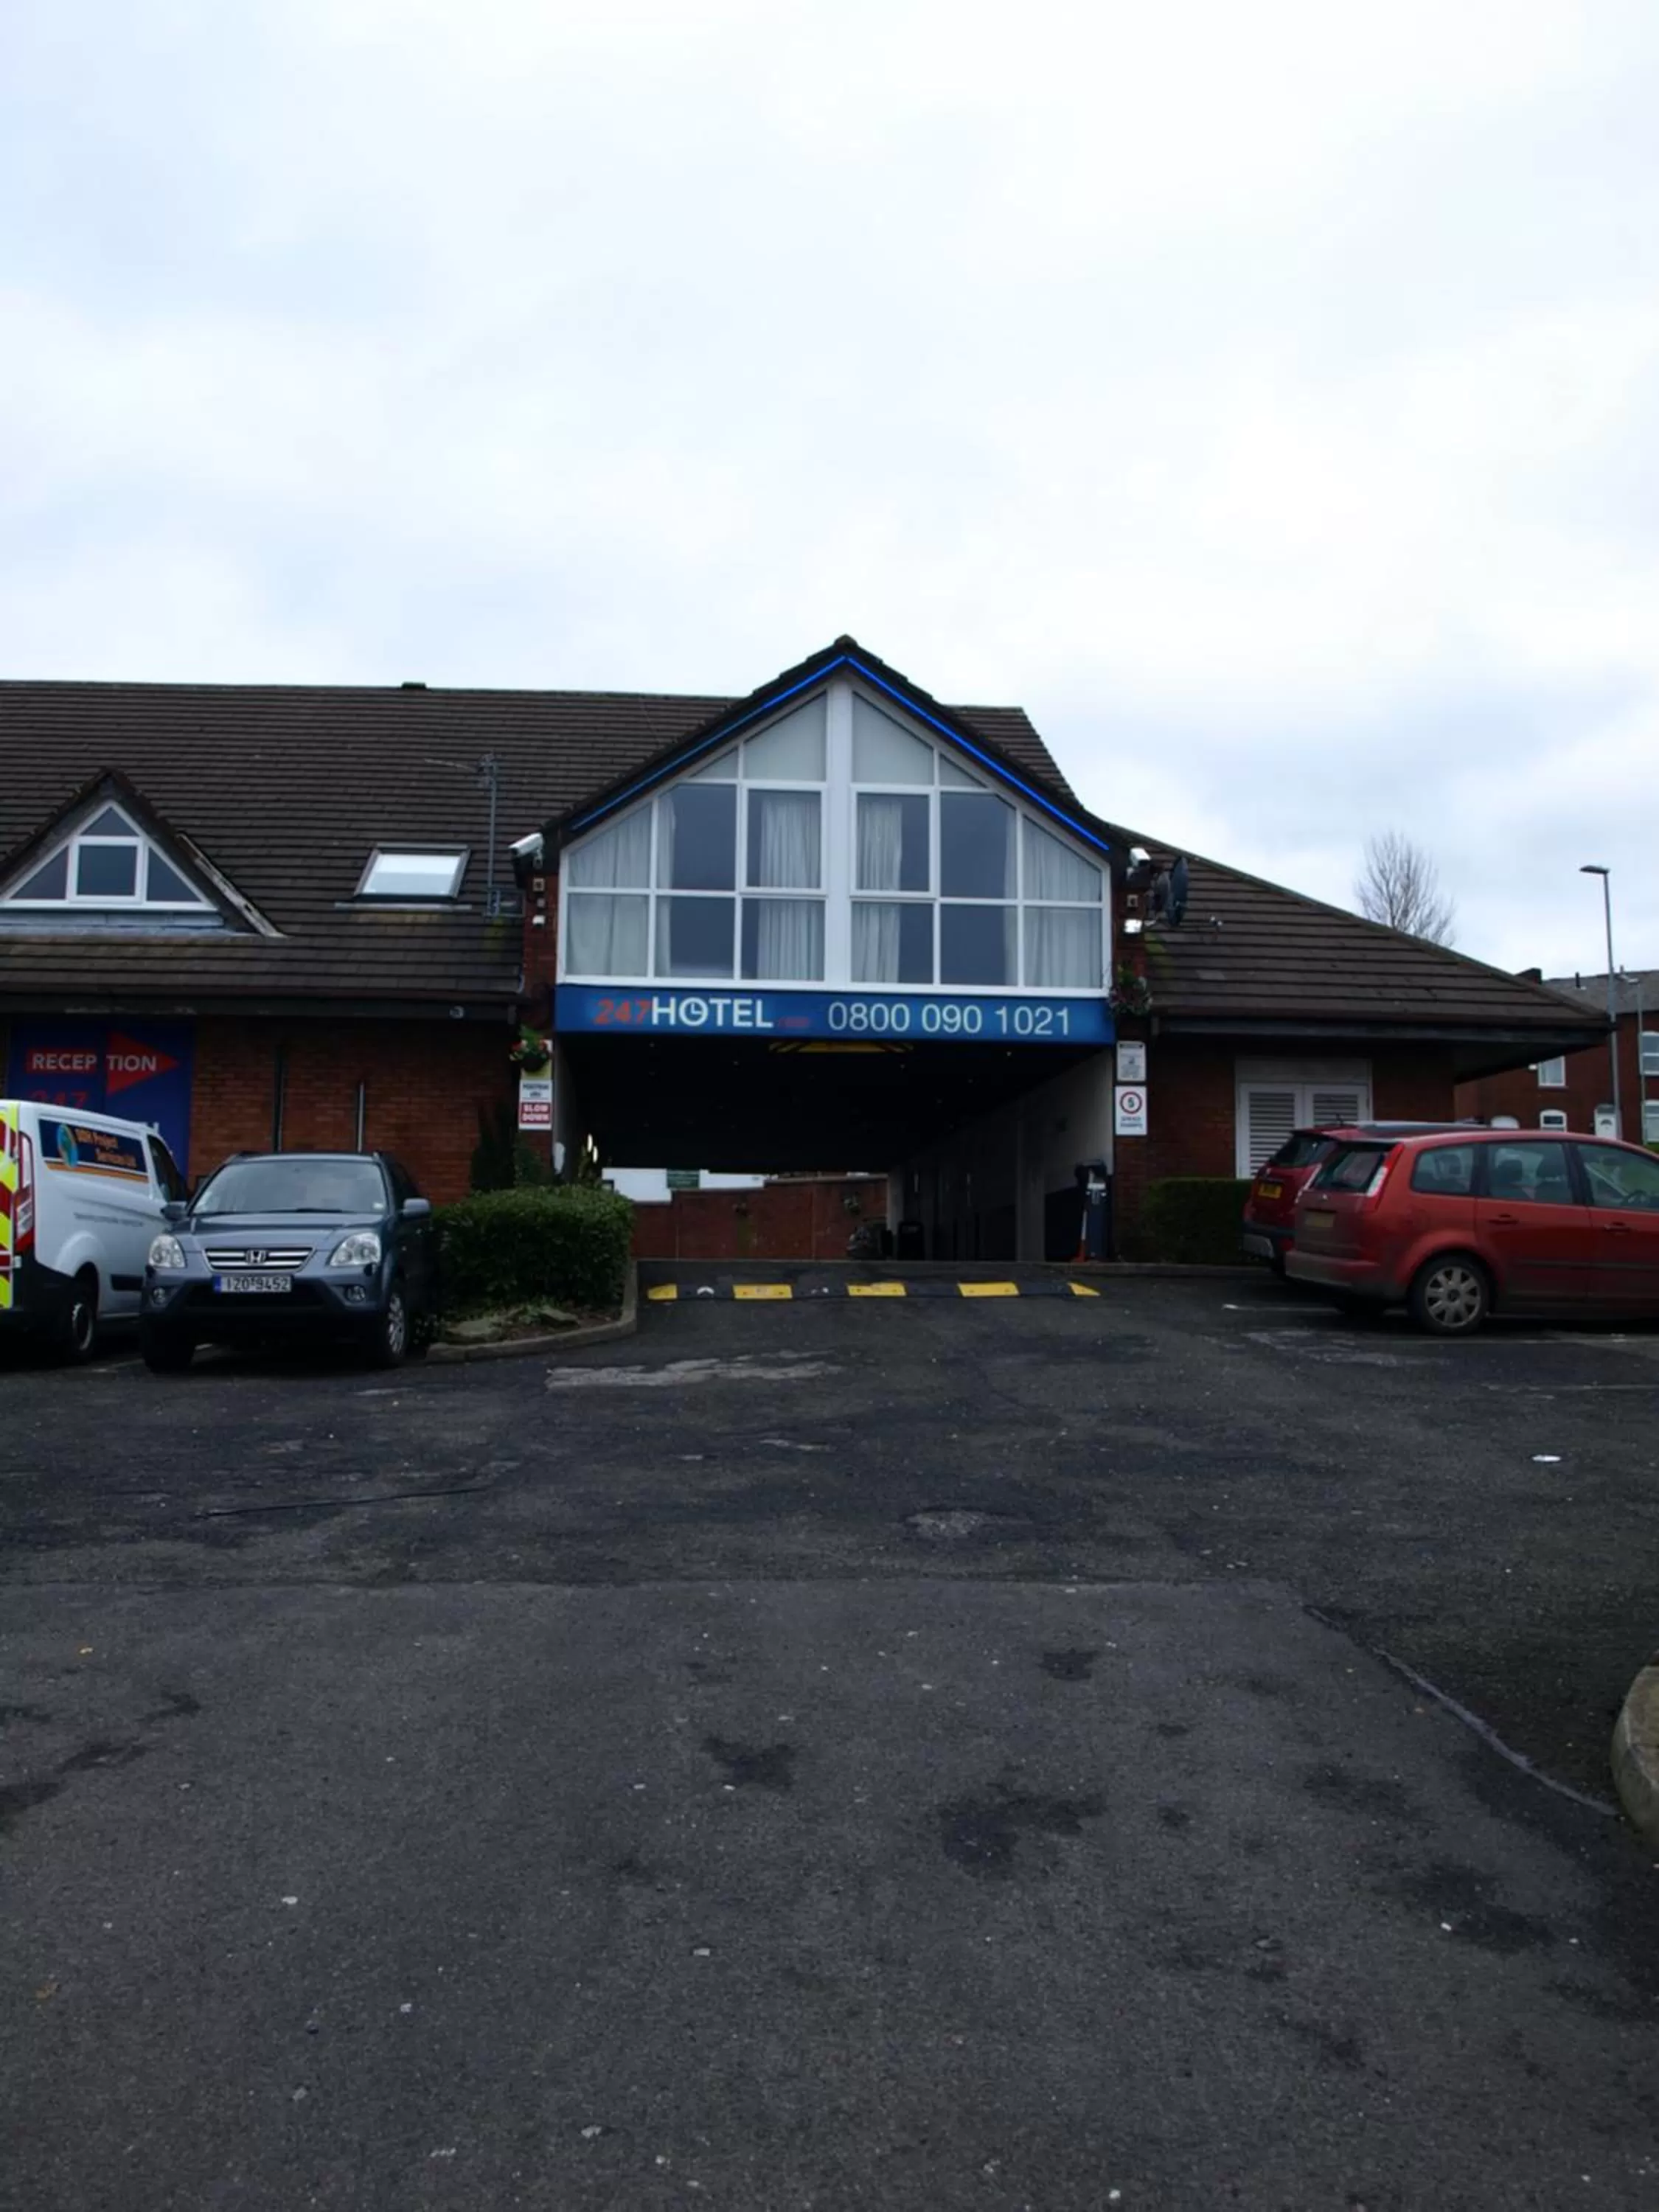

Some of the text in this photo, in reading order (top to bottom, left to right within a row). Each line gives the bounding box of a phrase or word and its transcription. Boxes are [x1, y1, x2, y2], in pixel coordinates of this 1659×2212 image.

[827, 1001, 910, 1032] 0800
[922, 1003, 982, 1034] 090
[994, 1005, 1069, 1036] 1021
